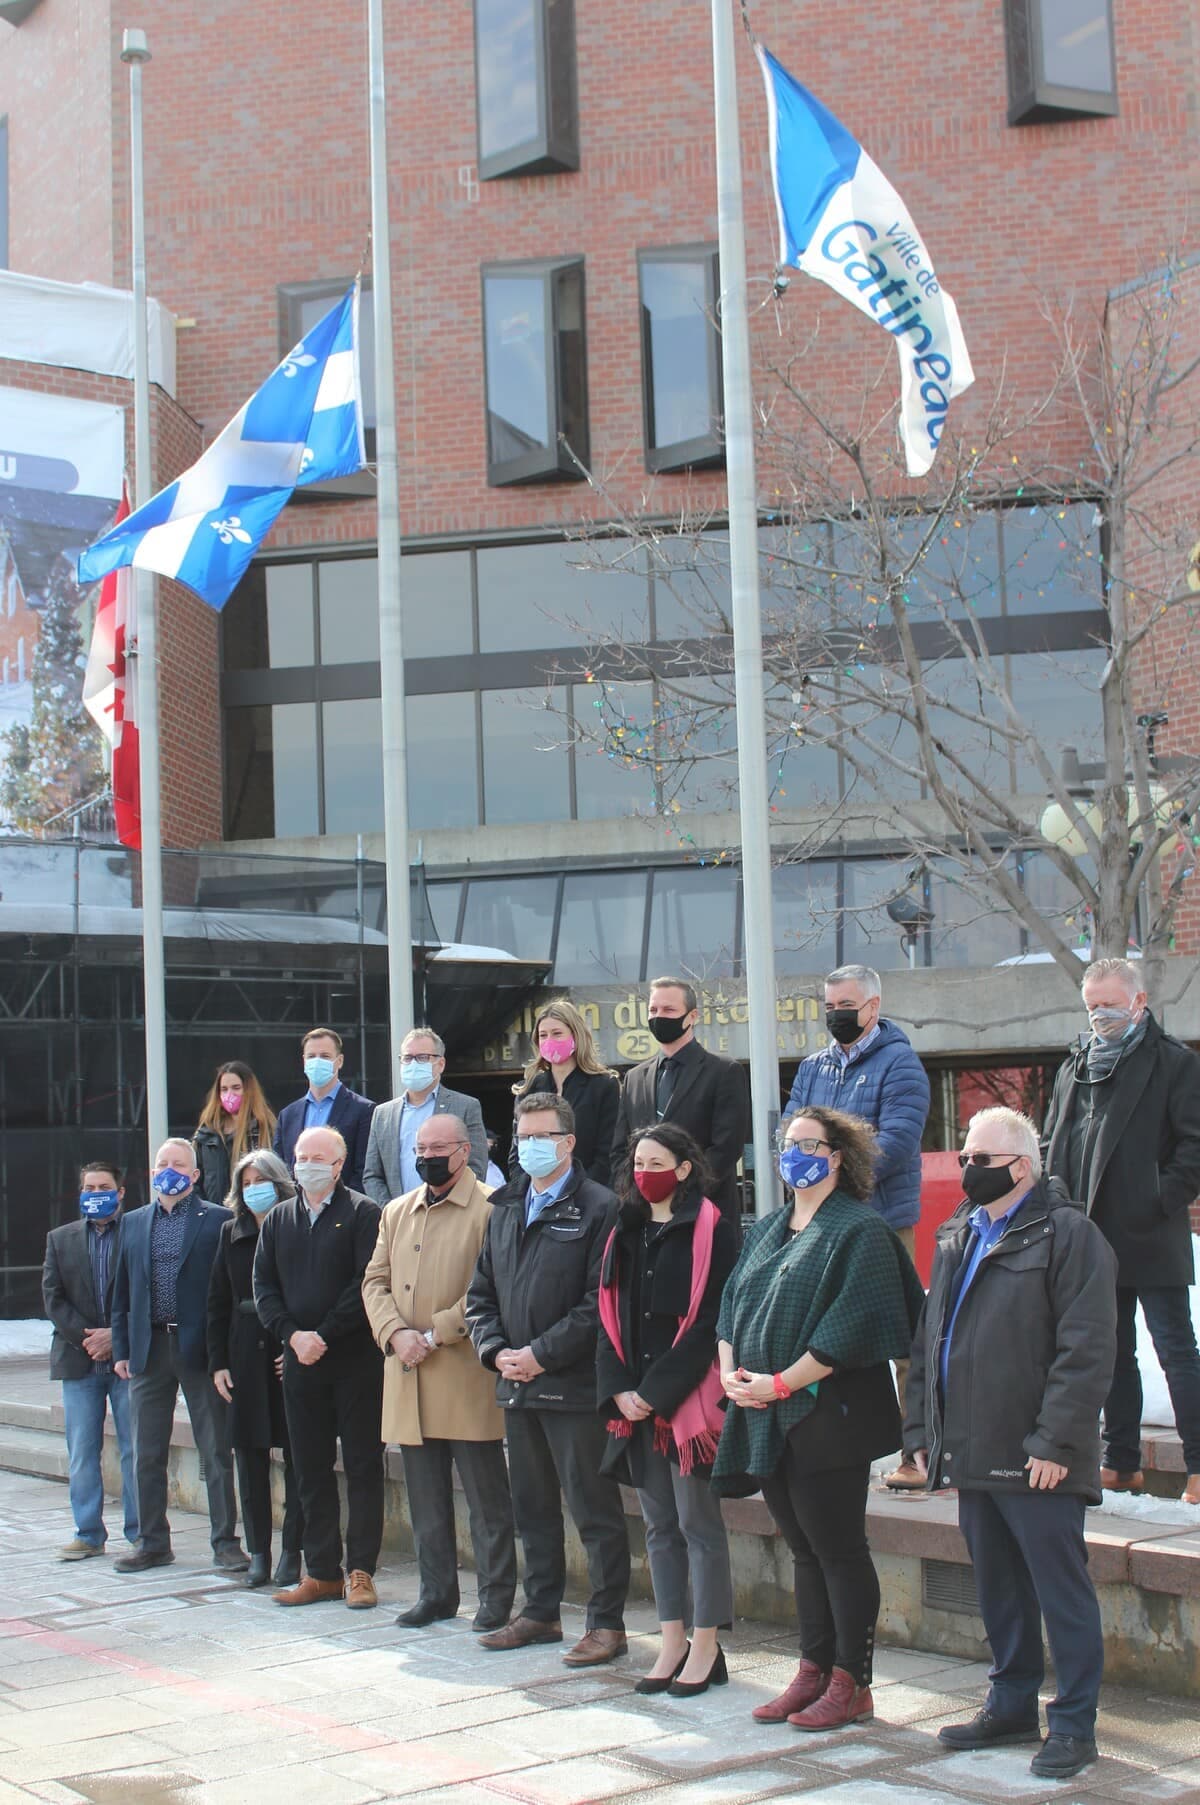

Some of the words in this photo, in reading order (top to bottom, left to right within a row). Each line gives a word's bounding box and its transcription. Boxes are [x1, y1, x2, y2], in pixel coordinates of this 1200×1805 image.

[885, 221, 920, 271] Ville
[916, 269, 939, 298] de
[820, 219, 952, 450] Gatineau
[626, 1034, 650, 1055] 25
